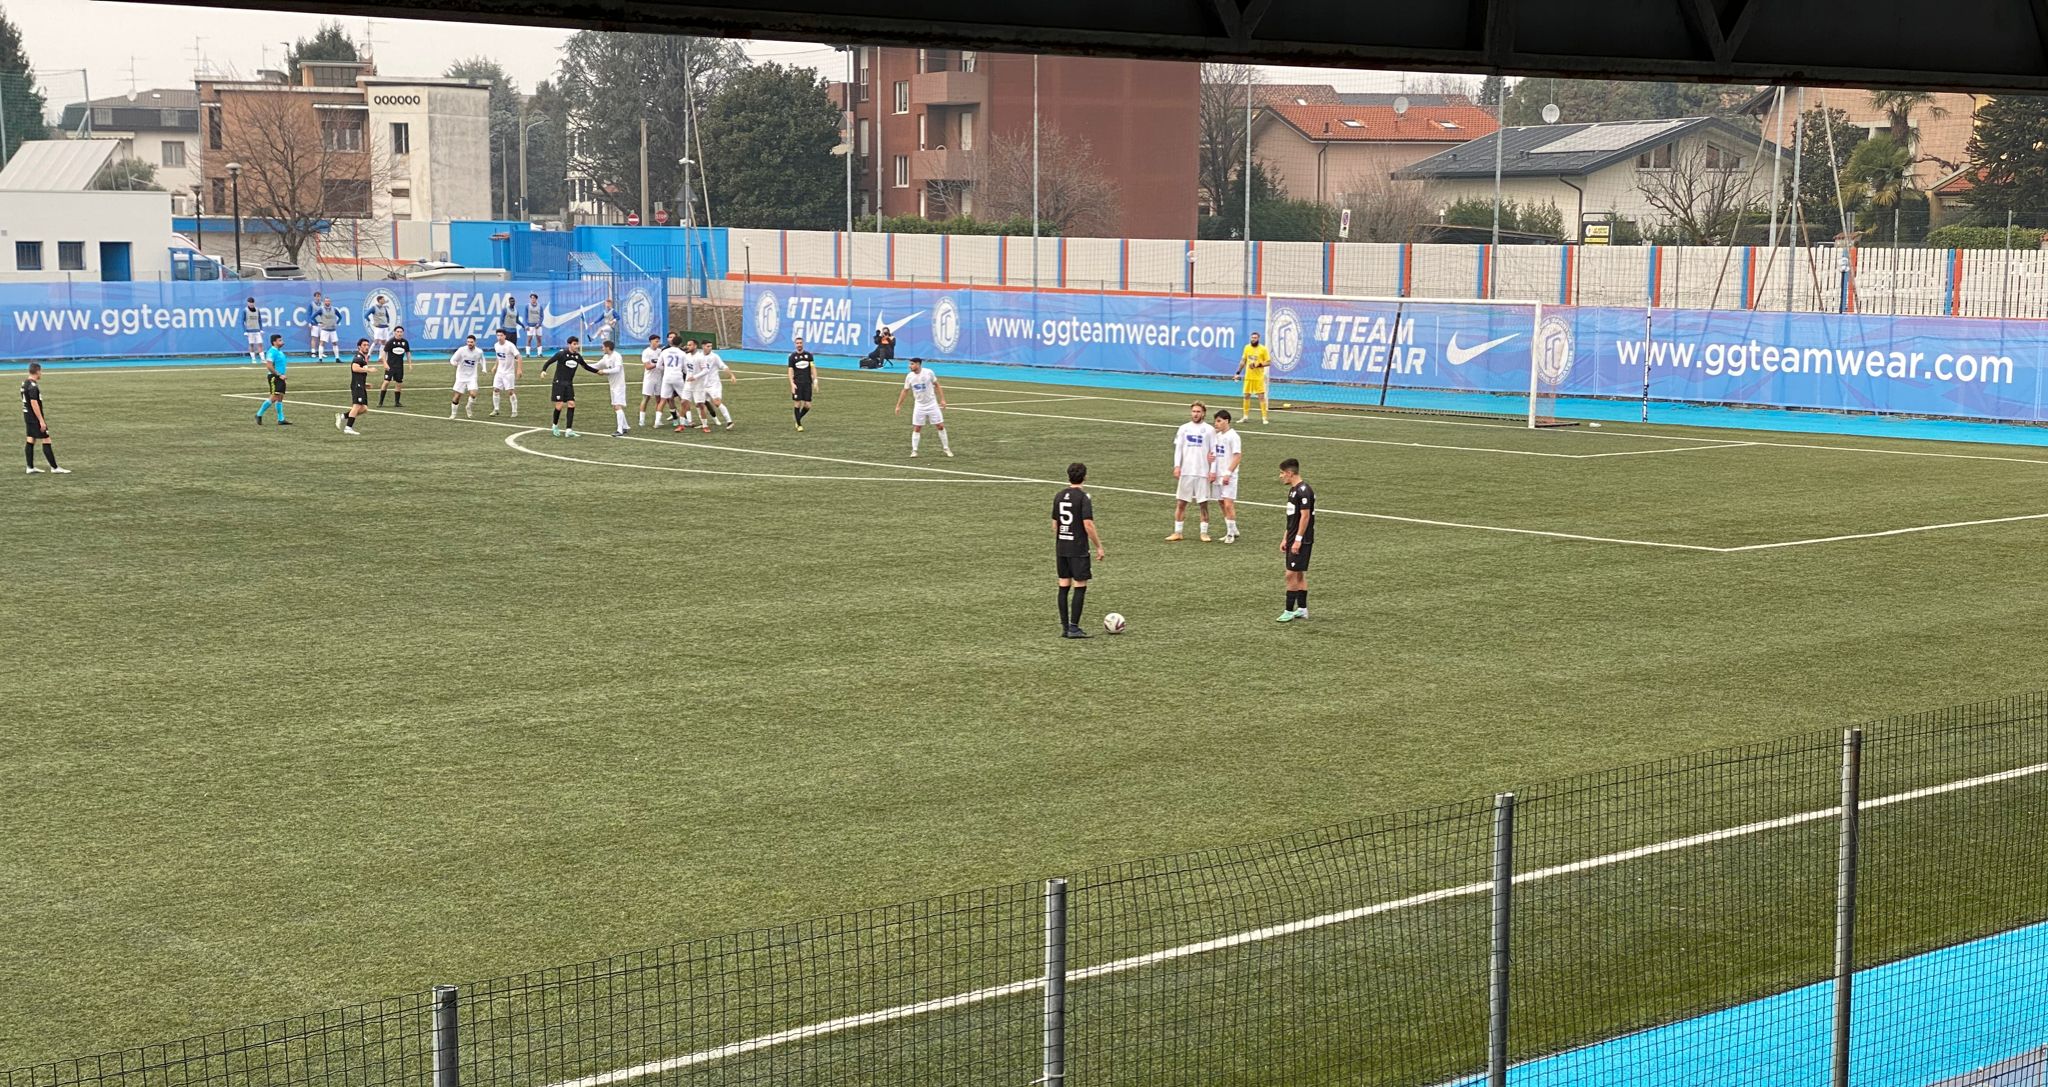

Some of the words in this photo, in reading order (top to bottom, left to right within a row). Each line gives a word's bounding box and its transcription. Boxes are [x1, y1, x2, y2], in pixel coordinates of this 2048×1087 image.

[13, 304, 350, 336] www.ggteamwar.c
[422, 316, 521, 340] GWEA
[986, 316, 1235, 348] www.ggteamwear.com
[667, 354, 679, 367] 21
[1616, 339, 2014, 384] www.ggteamwear.com
[1059, 501, 1073, 525] 5
